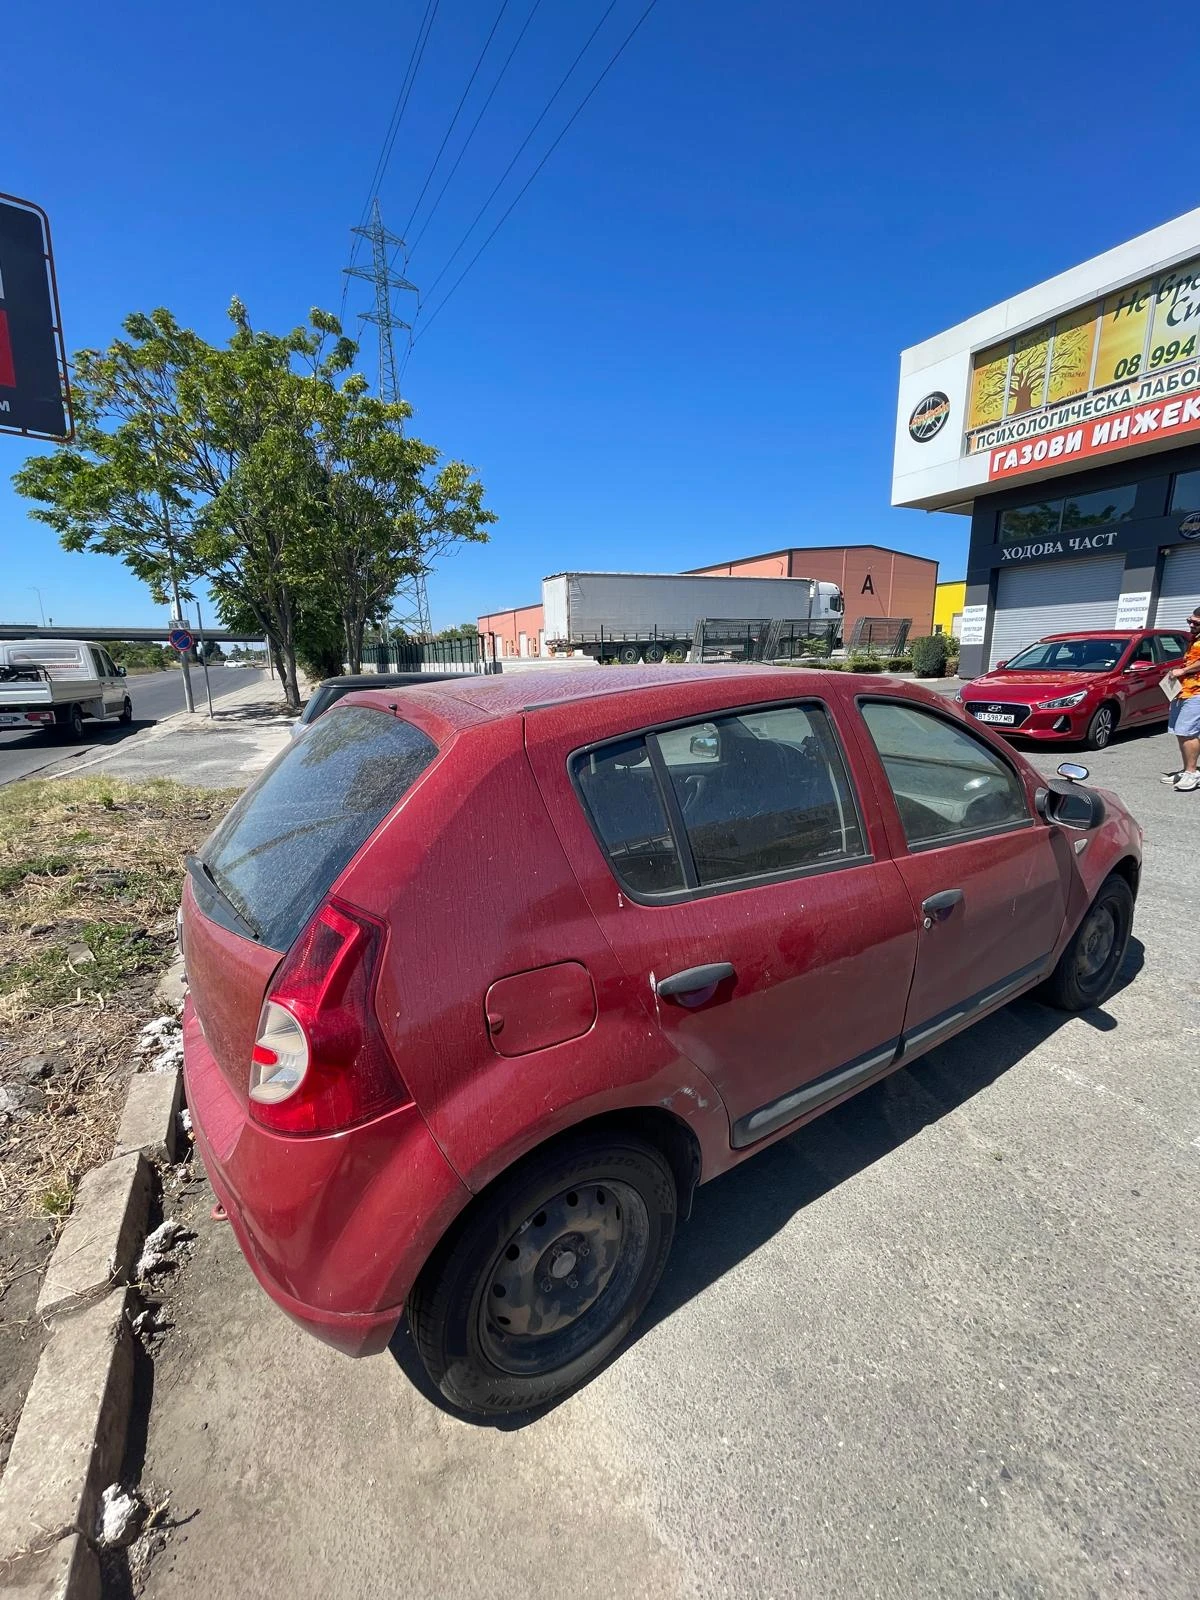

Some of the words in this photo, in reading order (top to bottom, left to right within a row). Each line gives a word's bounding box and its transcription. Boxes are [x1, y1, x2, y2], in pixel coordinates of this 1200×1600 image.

[1113, 288, 1151, 323] Не
[1114, 354, 1142, 381] 08
[1150, 335, 1197, 369] 994
[977, 388, 1133, 449] ПСИХОЛОГИЧЕСКА
[1136, 365, 1200, 402] ЛАБО
[992, 429, 1084, 473] ГАЗОВИ
[1091, 395, 1200, 448] ИНЖЕК
[1001, 541, 1063, 561] ХОДОВА
[1069, 532, 1117, 550] ЧАСТ
